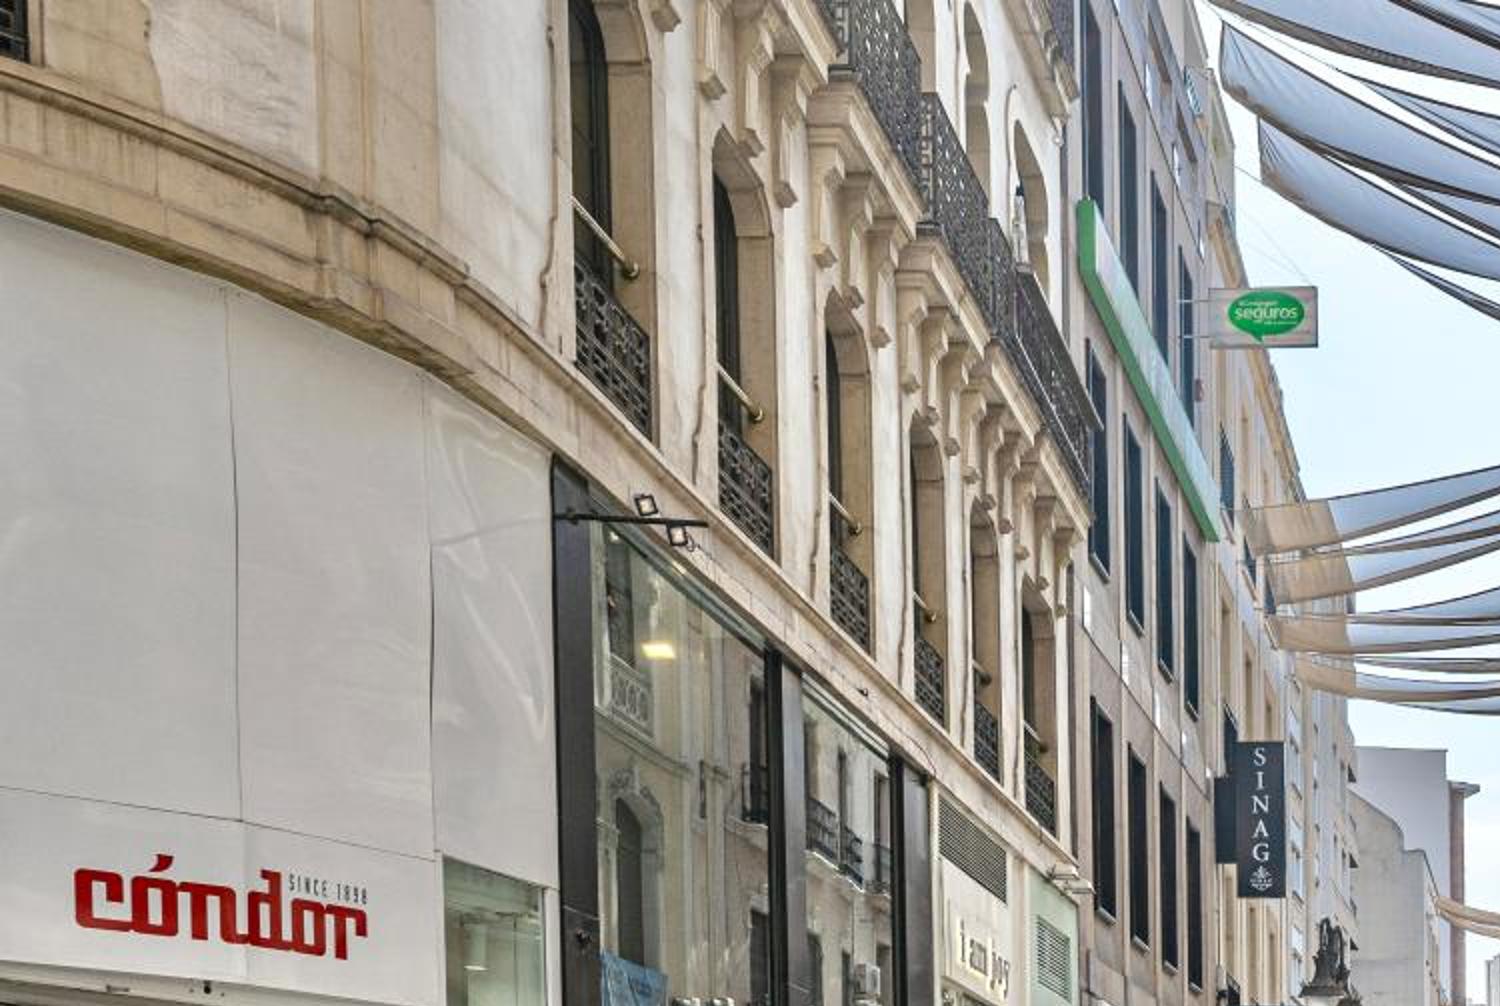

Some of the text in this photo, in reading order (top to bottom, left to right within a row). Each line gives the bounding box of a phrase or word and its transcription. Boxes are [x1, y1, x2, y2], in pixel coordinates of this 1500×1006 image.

[1235, 307, 1297, 324] seguros
[1252, 747, 1270, 863] SINAG
[74, 853, 368, 960] cóndor
[289, 873, 369, 905] SINCE 1898
